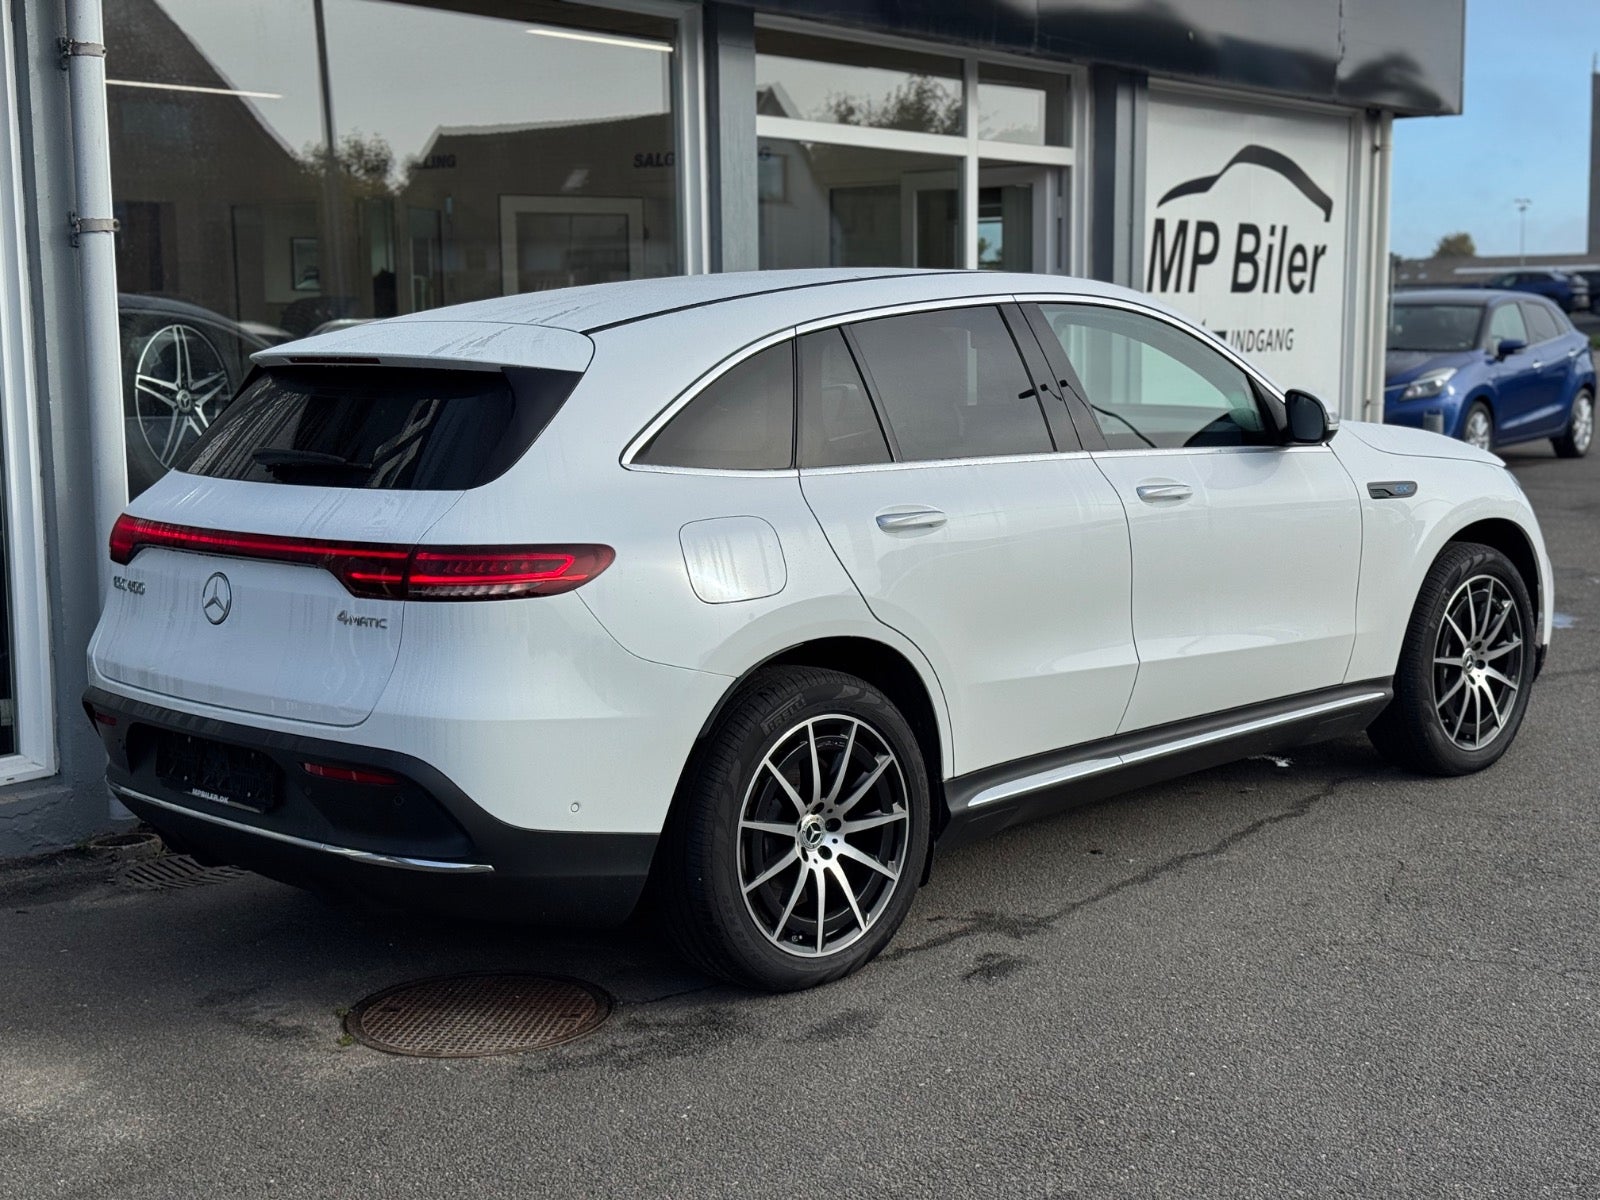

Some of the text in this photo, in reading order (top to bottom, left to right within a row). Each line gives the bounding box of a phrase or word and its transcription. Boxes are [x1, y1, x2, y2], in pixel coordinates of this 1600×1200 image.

[1146, 217, 1327, 295] MP Biler
[337, 609, 388, 629] 4MATIC
